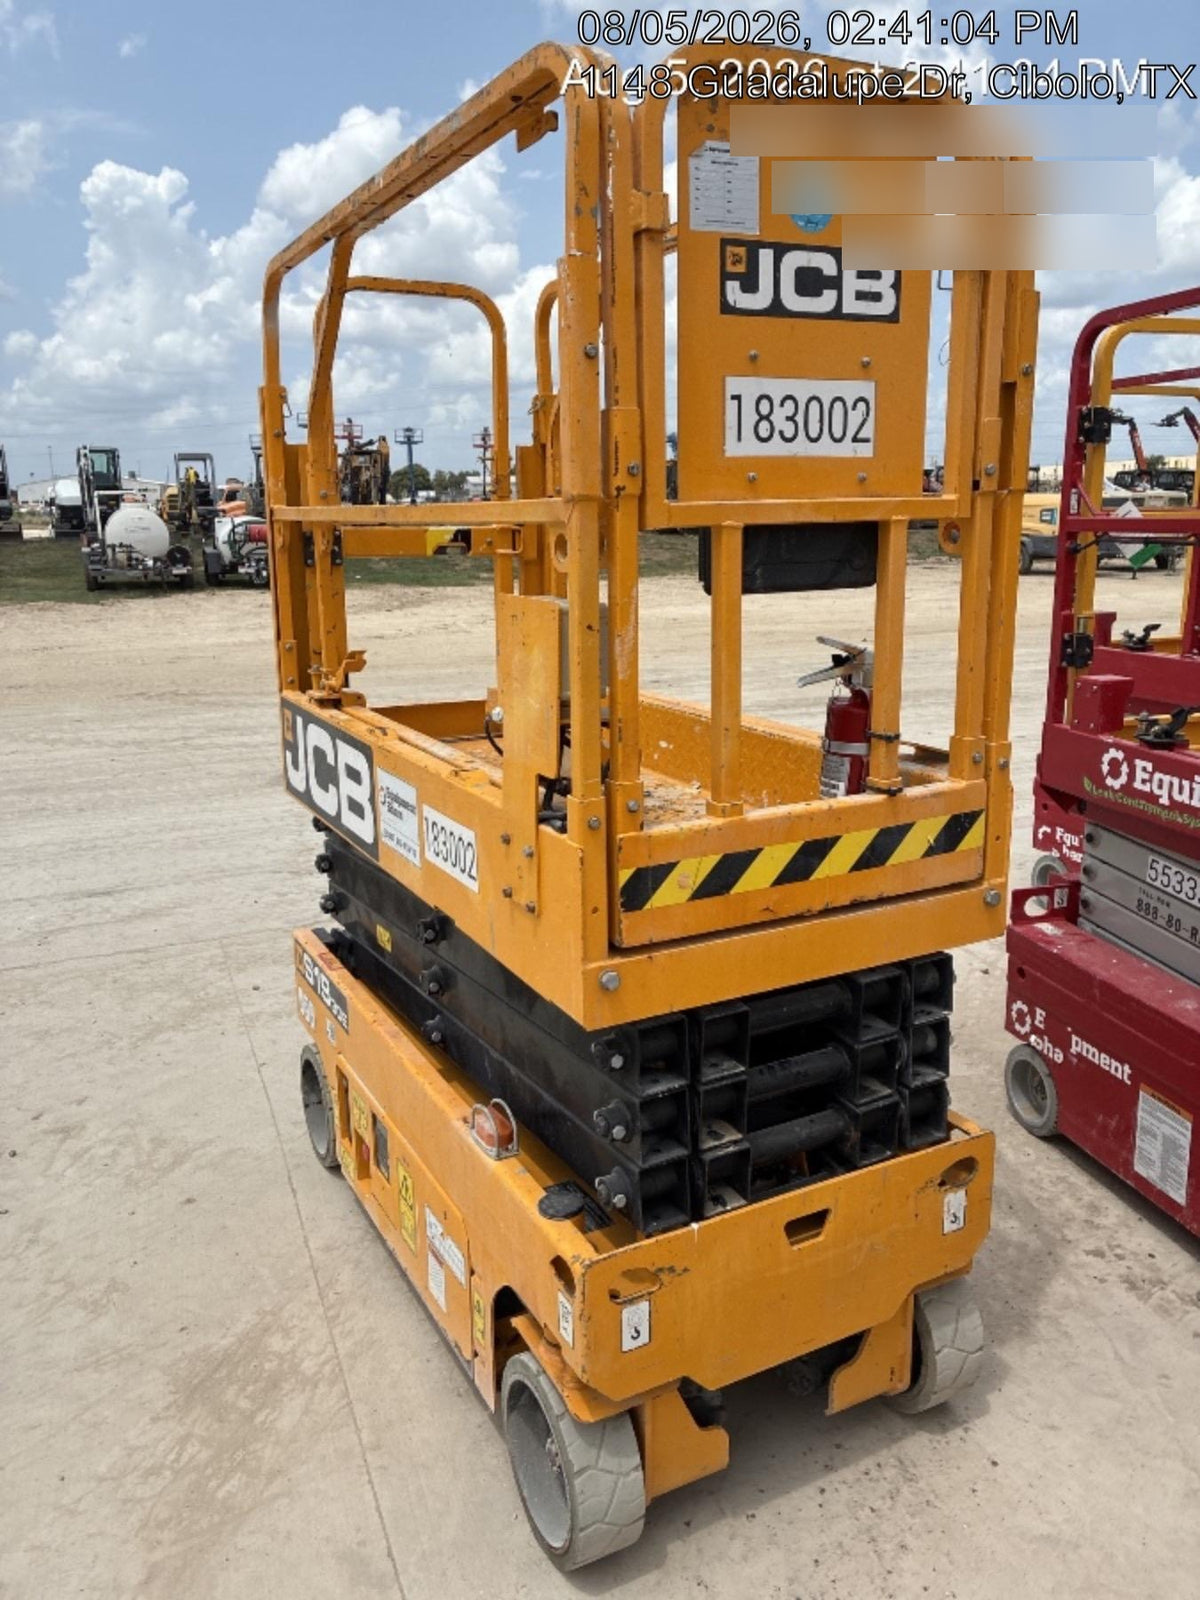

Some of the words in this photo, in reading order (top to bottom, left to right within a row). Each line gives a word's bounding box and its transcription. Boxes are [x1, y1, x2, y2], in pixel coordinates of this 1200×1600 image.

[726, 248, 897, 315] JCB
[730, 393, 871, 444] 183002
[286, 714, 375, 845] JCB
[424, 816, 478, 882] 183002
[1148, 858, 1200, 904] 5533
